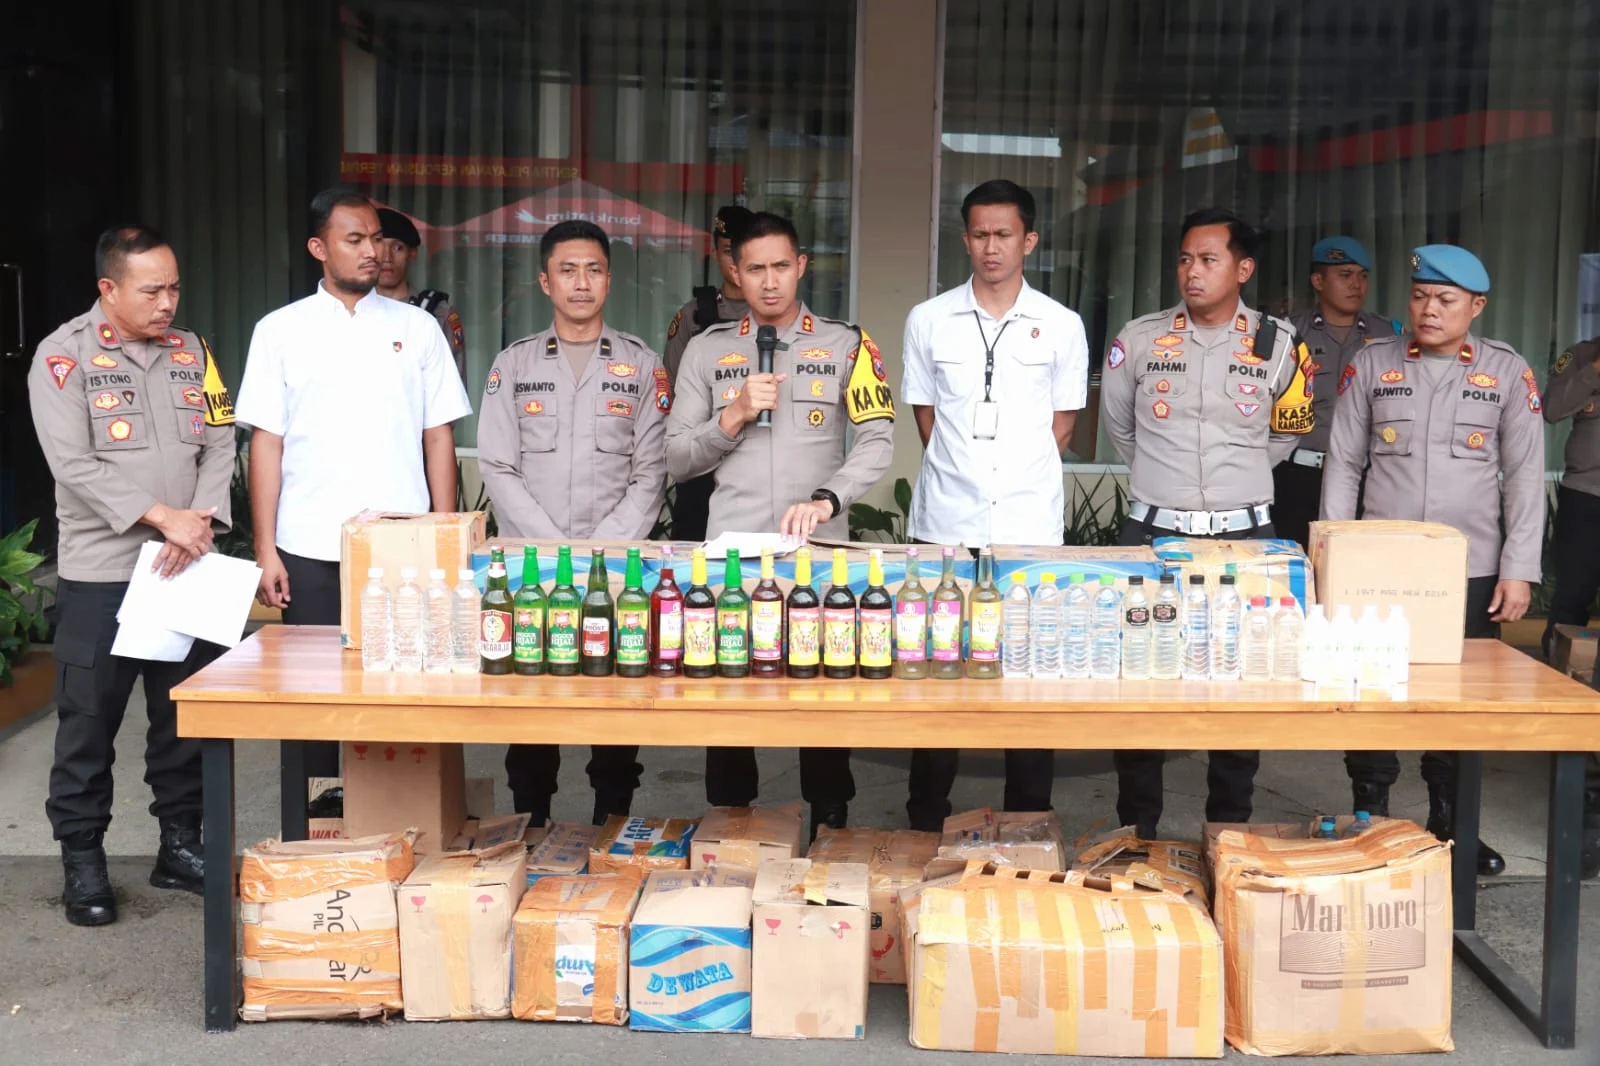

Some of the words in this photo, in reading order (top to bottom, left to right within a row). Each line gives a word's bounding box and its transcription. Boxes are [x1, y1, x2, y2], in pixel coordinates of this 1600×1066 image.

[715, 367, 750, 381] BAYU
[796, 364, 836, 376] POLRI
[1146, 362, 1187, 373] FAHMI
[1228, 364, 1268, 380] POLRI
[90, 374, 132, 388] ISTONO
[170, 370, 201, 382] POLR
[601, 382, 639, 395] POLRI
[1373, 386, 1413, 398] SUWITO
[852, 387, 874, 414] KA
[1462, 389, 1501, 404] POLRI
[645, 961, 735, 996] DEWATA
